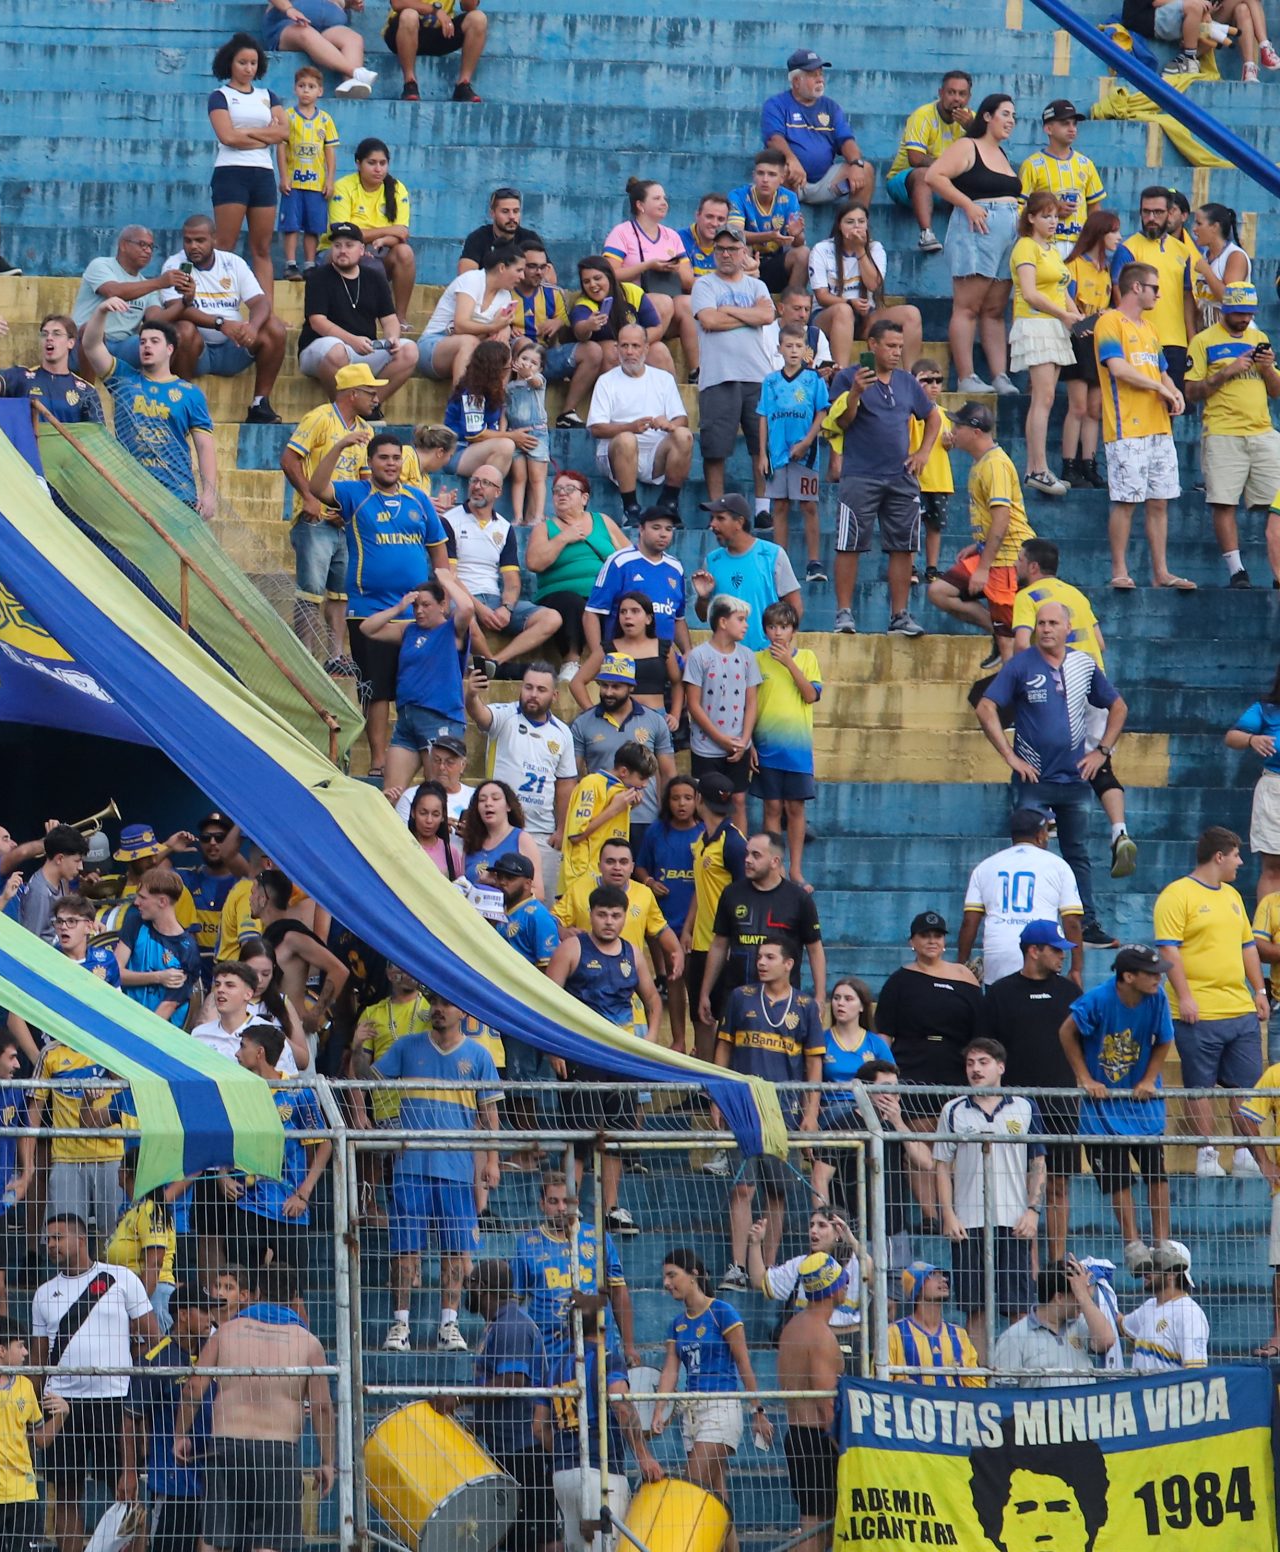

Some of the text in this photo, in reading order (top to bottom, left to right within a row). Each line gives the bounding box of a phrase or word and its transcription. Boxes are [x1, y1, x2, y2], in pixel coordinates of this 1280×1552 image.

[518, 771, 547, 793] 21
[998, 870, 1036, 913] 10
[847, 1376, 1230, 1448] PELOTAS MINHA VIDA
[852, 1487, 936, 1517] ADEMIR
[1134, 1465, 1256, 1535] 1984
